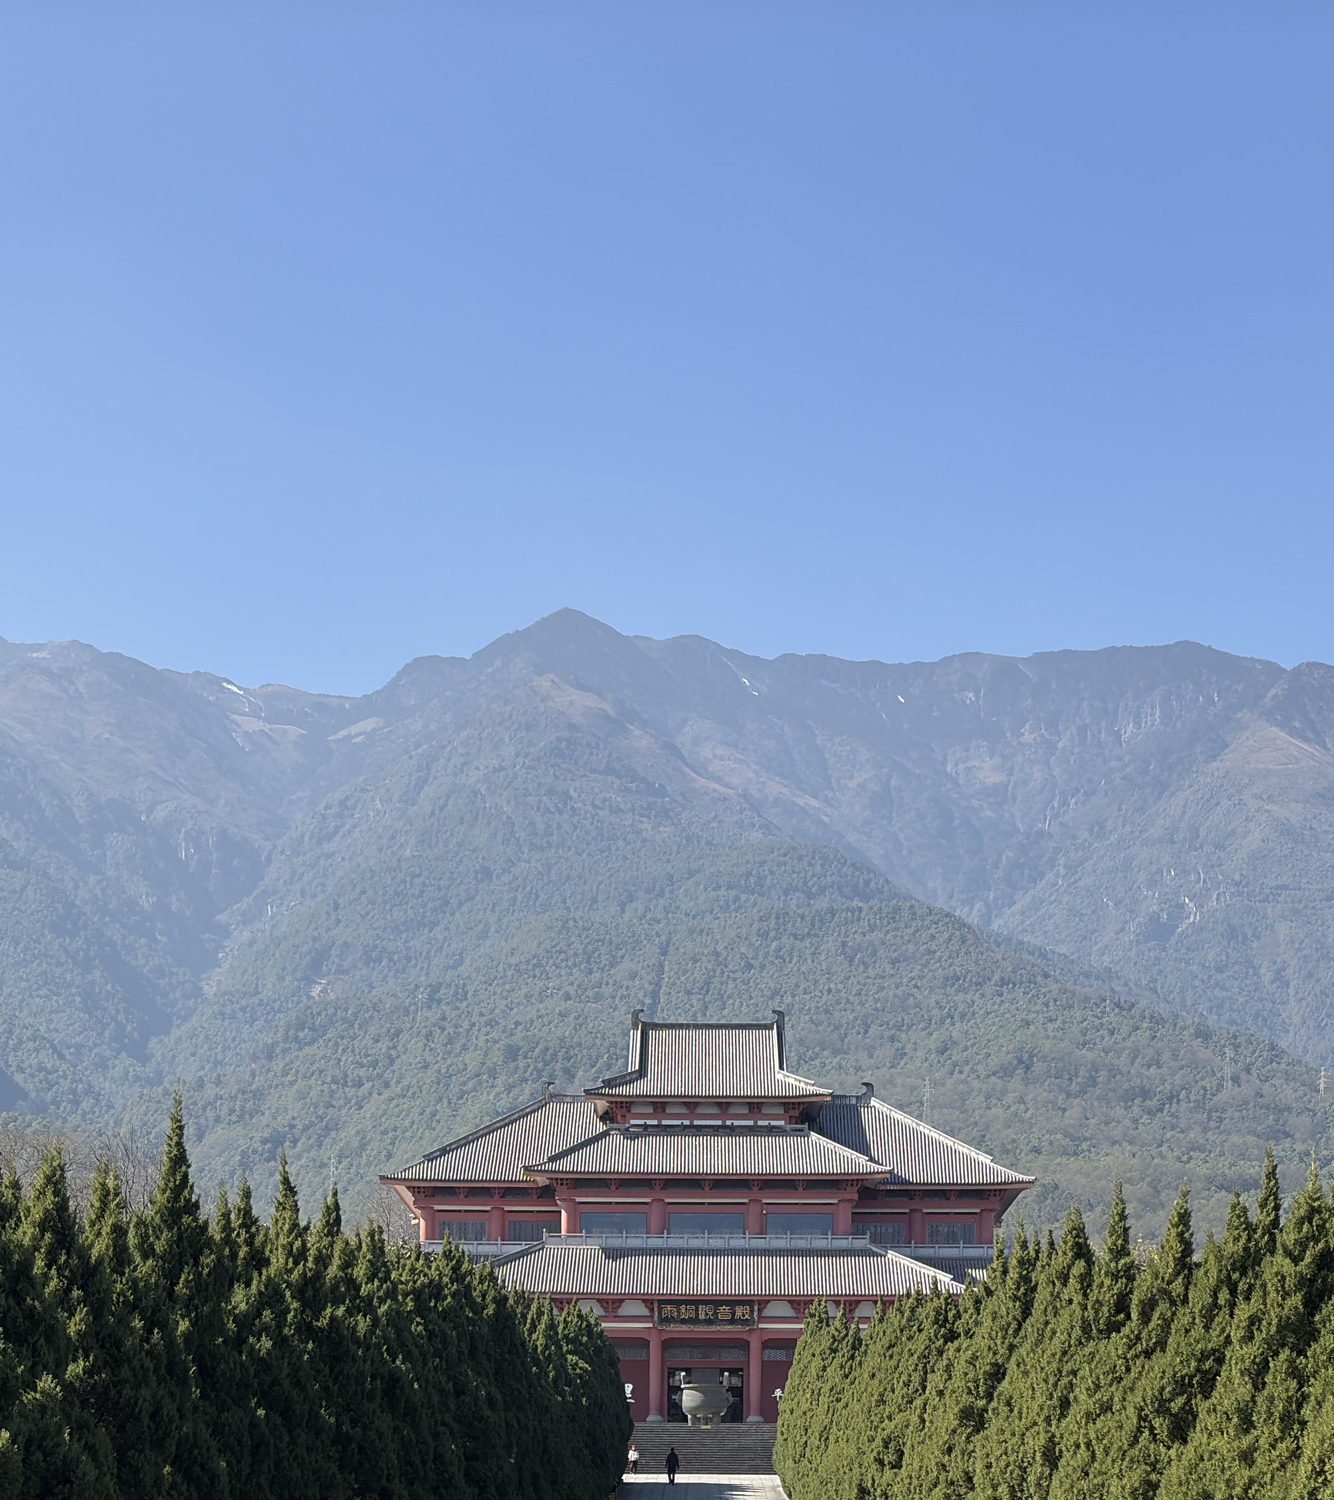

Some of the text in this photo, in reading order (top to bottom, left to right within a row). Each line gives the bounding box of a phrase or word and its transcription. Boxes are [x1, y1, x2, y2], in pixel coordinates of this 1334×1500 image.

[661, 1304, 751, 1320] 雨銅觀音殿
